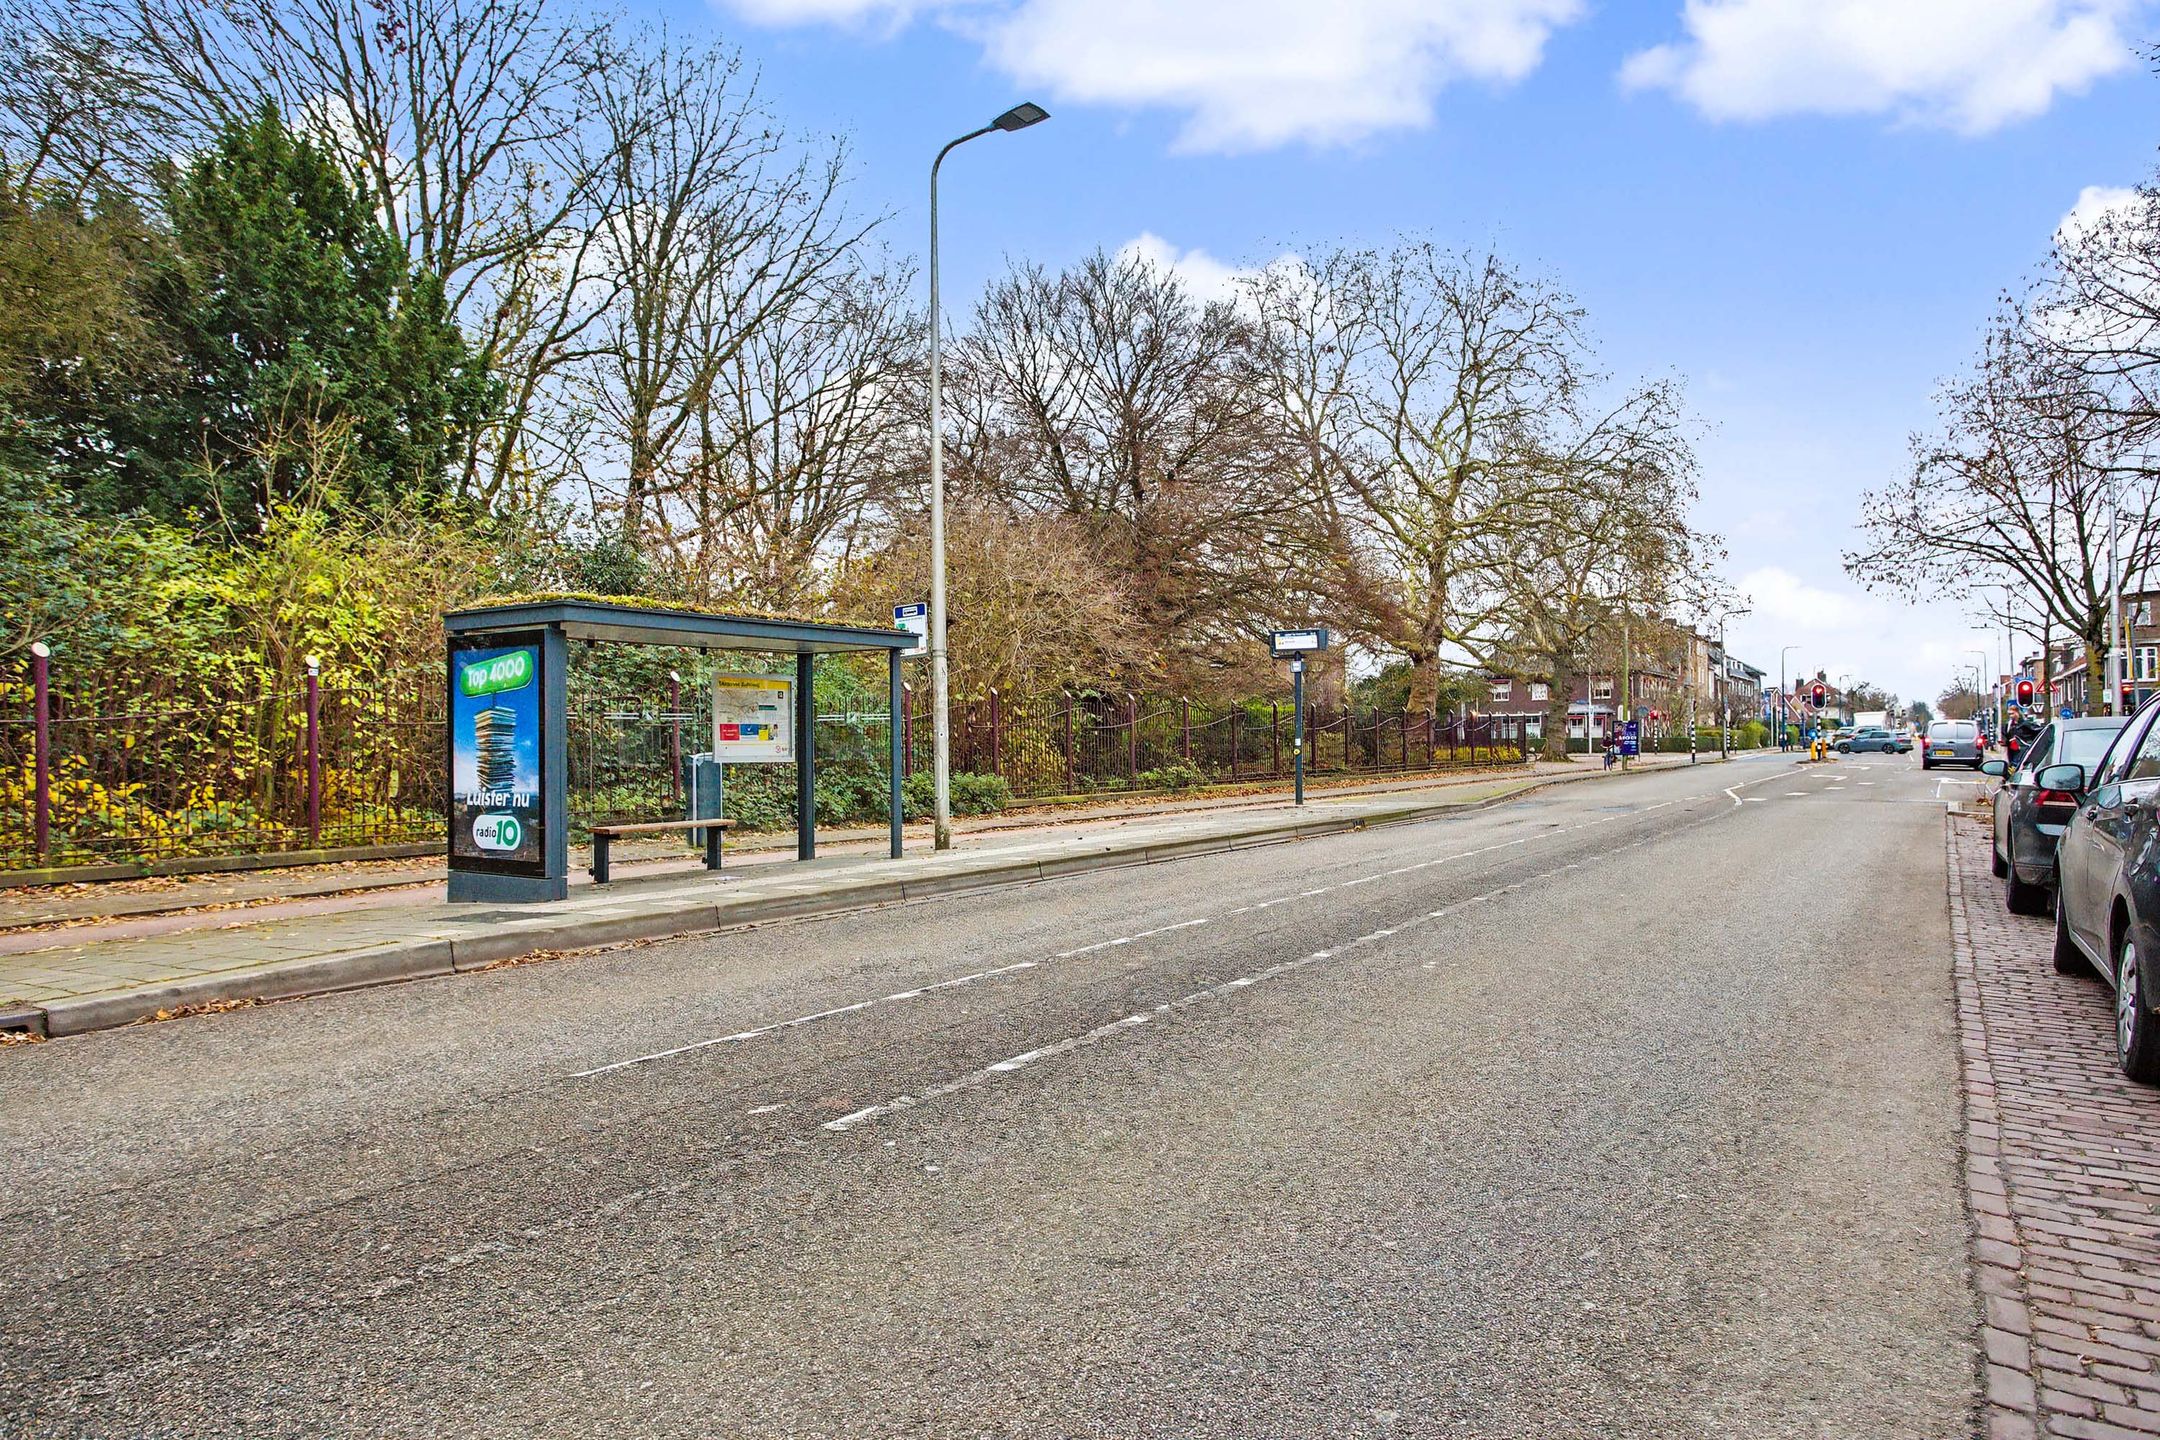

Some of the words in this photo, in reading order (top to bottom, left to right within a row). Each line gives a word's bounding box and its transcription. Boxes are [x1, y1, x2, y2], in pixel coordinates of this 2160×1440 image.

[467, 669, 487, 689] Top
[490, 656, 525, 682] 4000
[467, 787, 510, 807] Luister
[512, 793, 530, 808] nu
